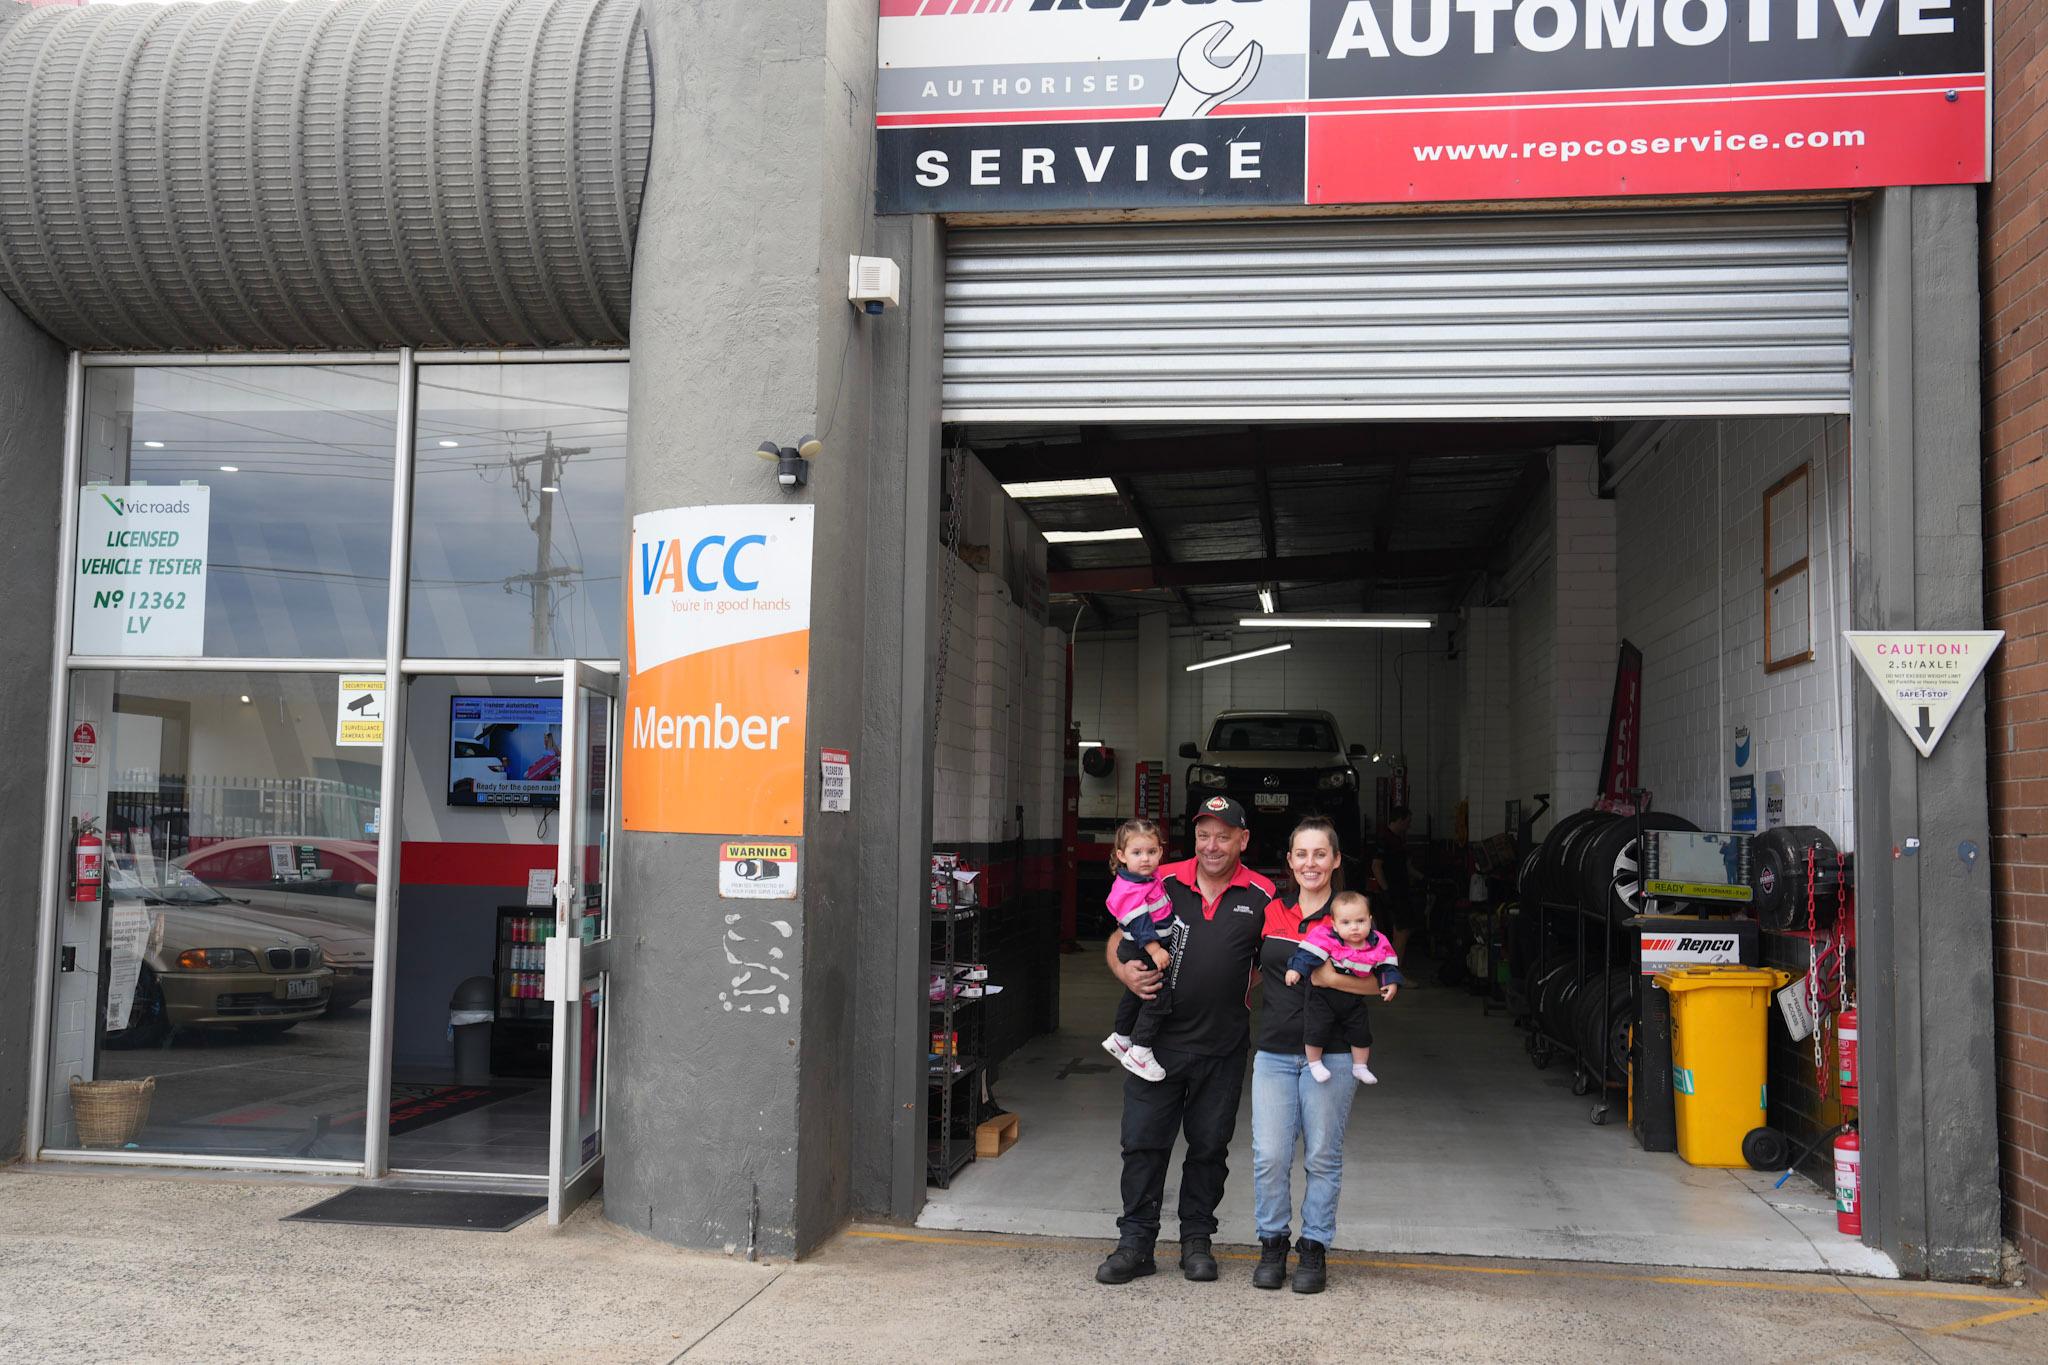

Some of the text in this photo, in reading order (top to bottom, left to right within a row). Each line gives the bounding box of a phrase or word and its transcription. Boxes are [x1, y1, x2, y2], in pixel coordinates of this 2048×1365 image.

[1326, 0, 1957, 61] AUTOMOTIVE
[921, 73, 1146, 98] AUTHORISED
[1413, 128, 1866, 163] www.repcoservice.com
[915, 141, 1262, 187] SERVICE
[107, 531, 179, 547] LICENSED
[82, 558, 203, 575] VEHICLE TESTER
[642, 534, 767, 596] VACC
[129, 591, 187, 610] 12362
[704, 599, 714, 611] in
[716, 598, 749, 614] good
[753, 598, 791, 611] hands
[127, 616, 152, 634] LV
[1877, 644, 1969, 655] CAUTION!
[633, 703, 790, 751] Member
[476, 783, 497, 791] Ready
[522, 784, 539, 792] open
[730, 847, 787, 857] WARNING
[1654, 882, 1685, 893] READY
[1677, 938, 1734, 953] Repco
[1172, 924, 1190, 989] AUTHORISED SERVICE
